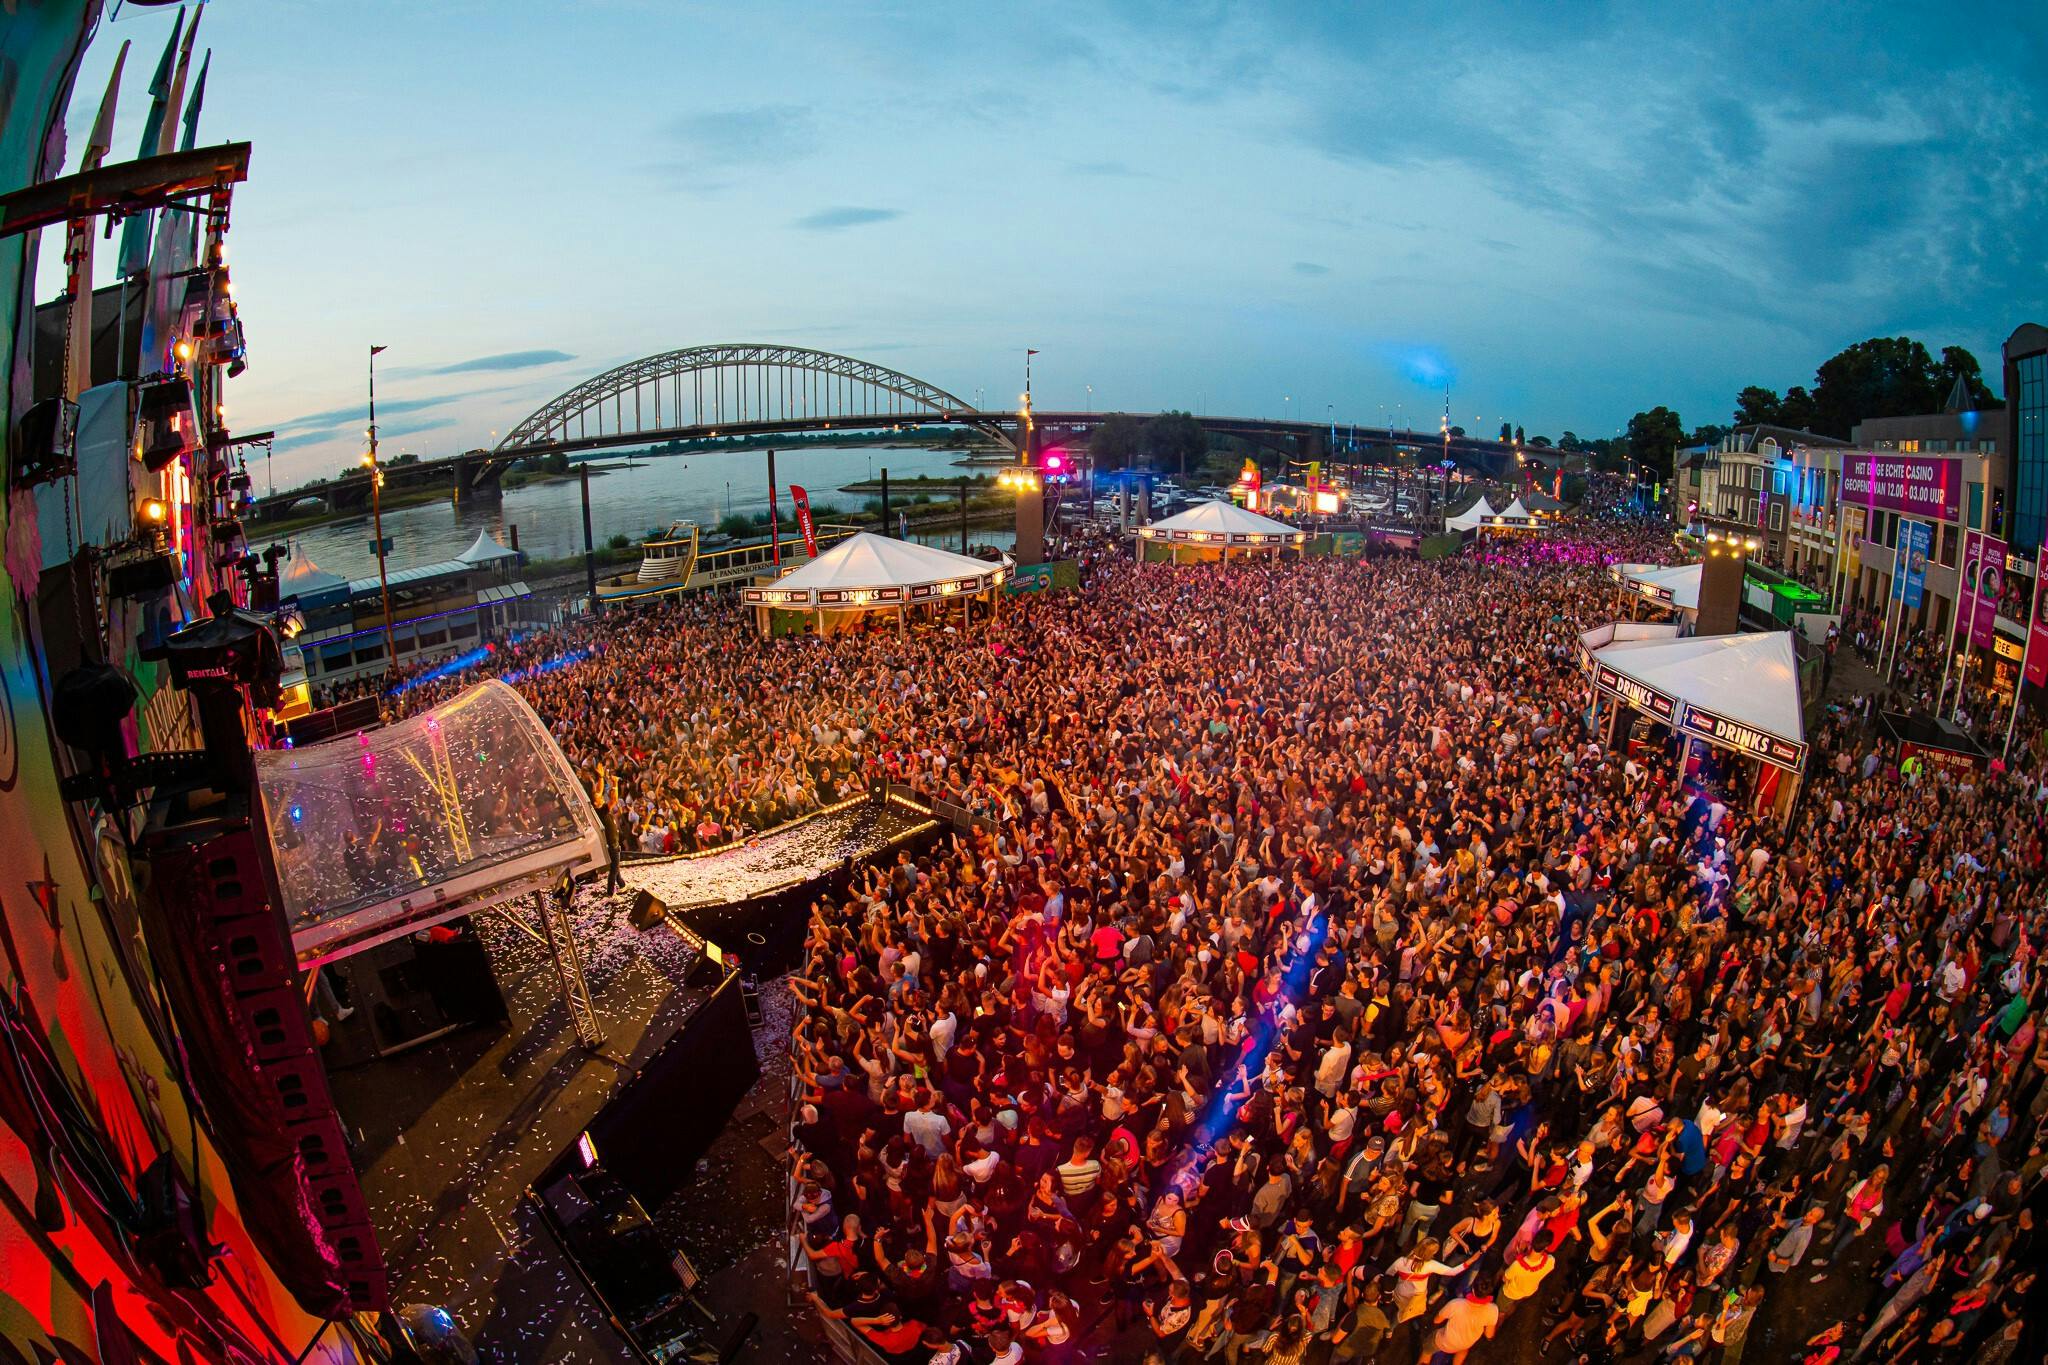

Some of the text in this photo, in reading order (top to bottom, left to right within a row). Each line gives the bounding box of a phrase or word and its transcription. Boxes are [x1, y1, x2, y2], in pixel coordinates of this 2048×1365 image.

[1855, 462, 1933, 481] HET EGE ECHTE CASINO
[1844, 478, 1872, 494] GEOPEND
[1874, 482, 1886, 496] VAN
[1887, 483, 1904, 498] 12.00
[1909, 487, 1928, 503] 03.00
[1930, 488, 1944, 504] UUR
[1187, 532, 1212, 541] DRINKS
[709, 560, 786, 580] DE PANNENKOEKEN
[841, 589, 879, 602] DRINKS
[930, 581, 962, 595] DRINKS
[762, 591, 792, 602] DRINKS
[187, 666, 228, 679] RENTALL
[1616, 676, 1653, 706] DRINKS
[1715, 719, 1770, 753] DRINKS
